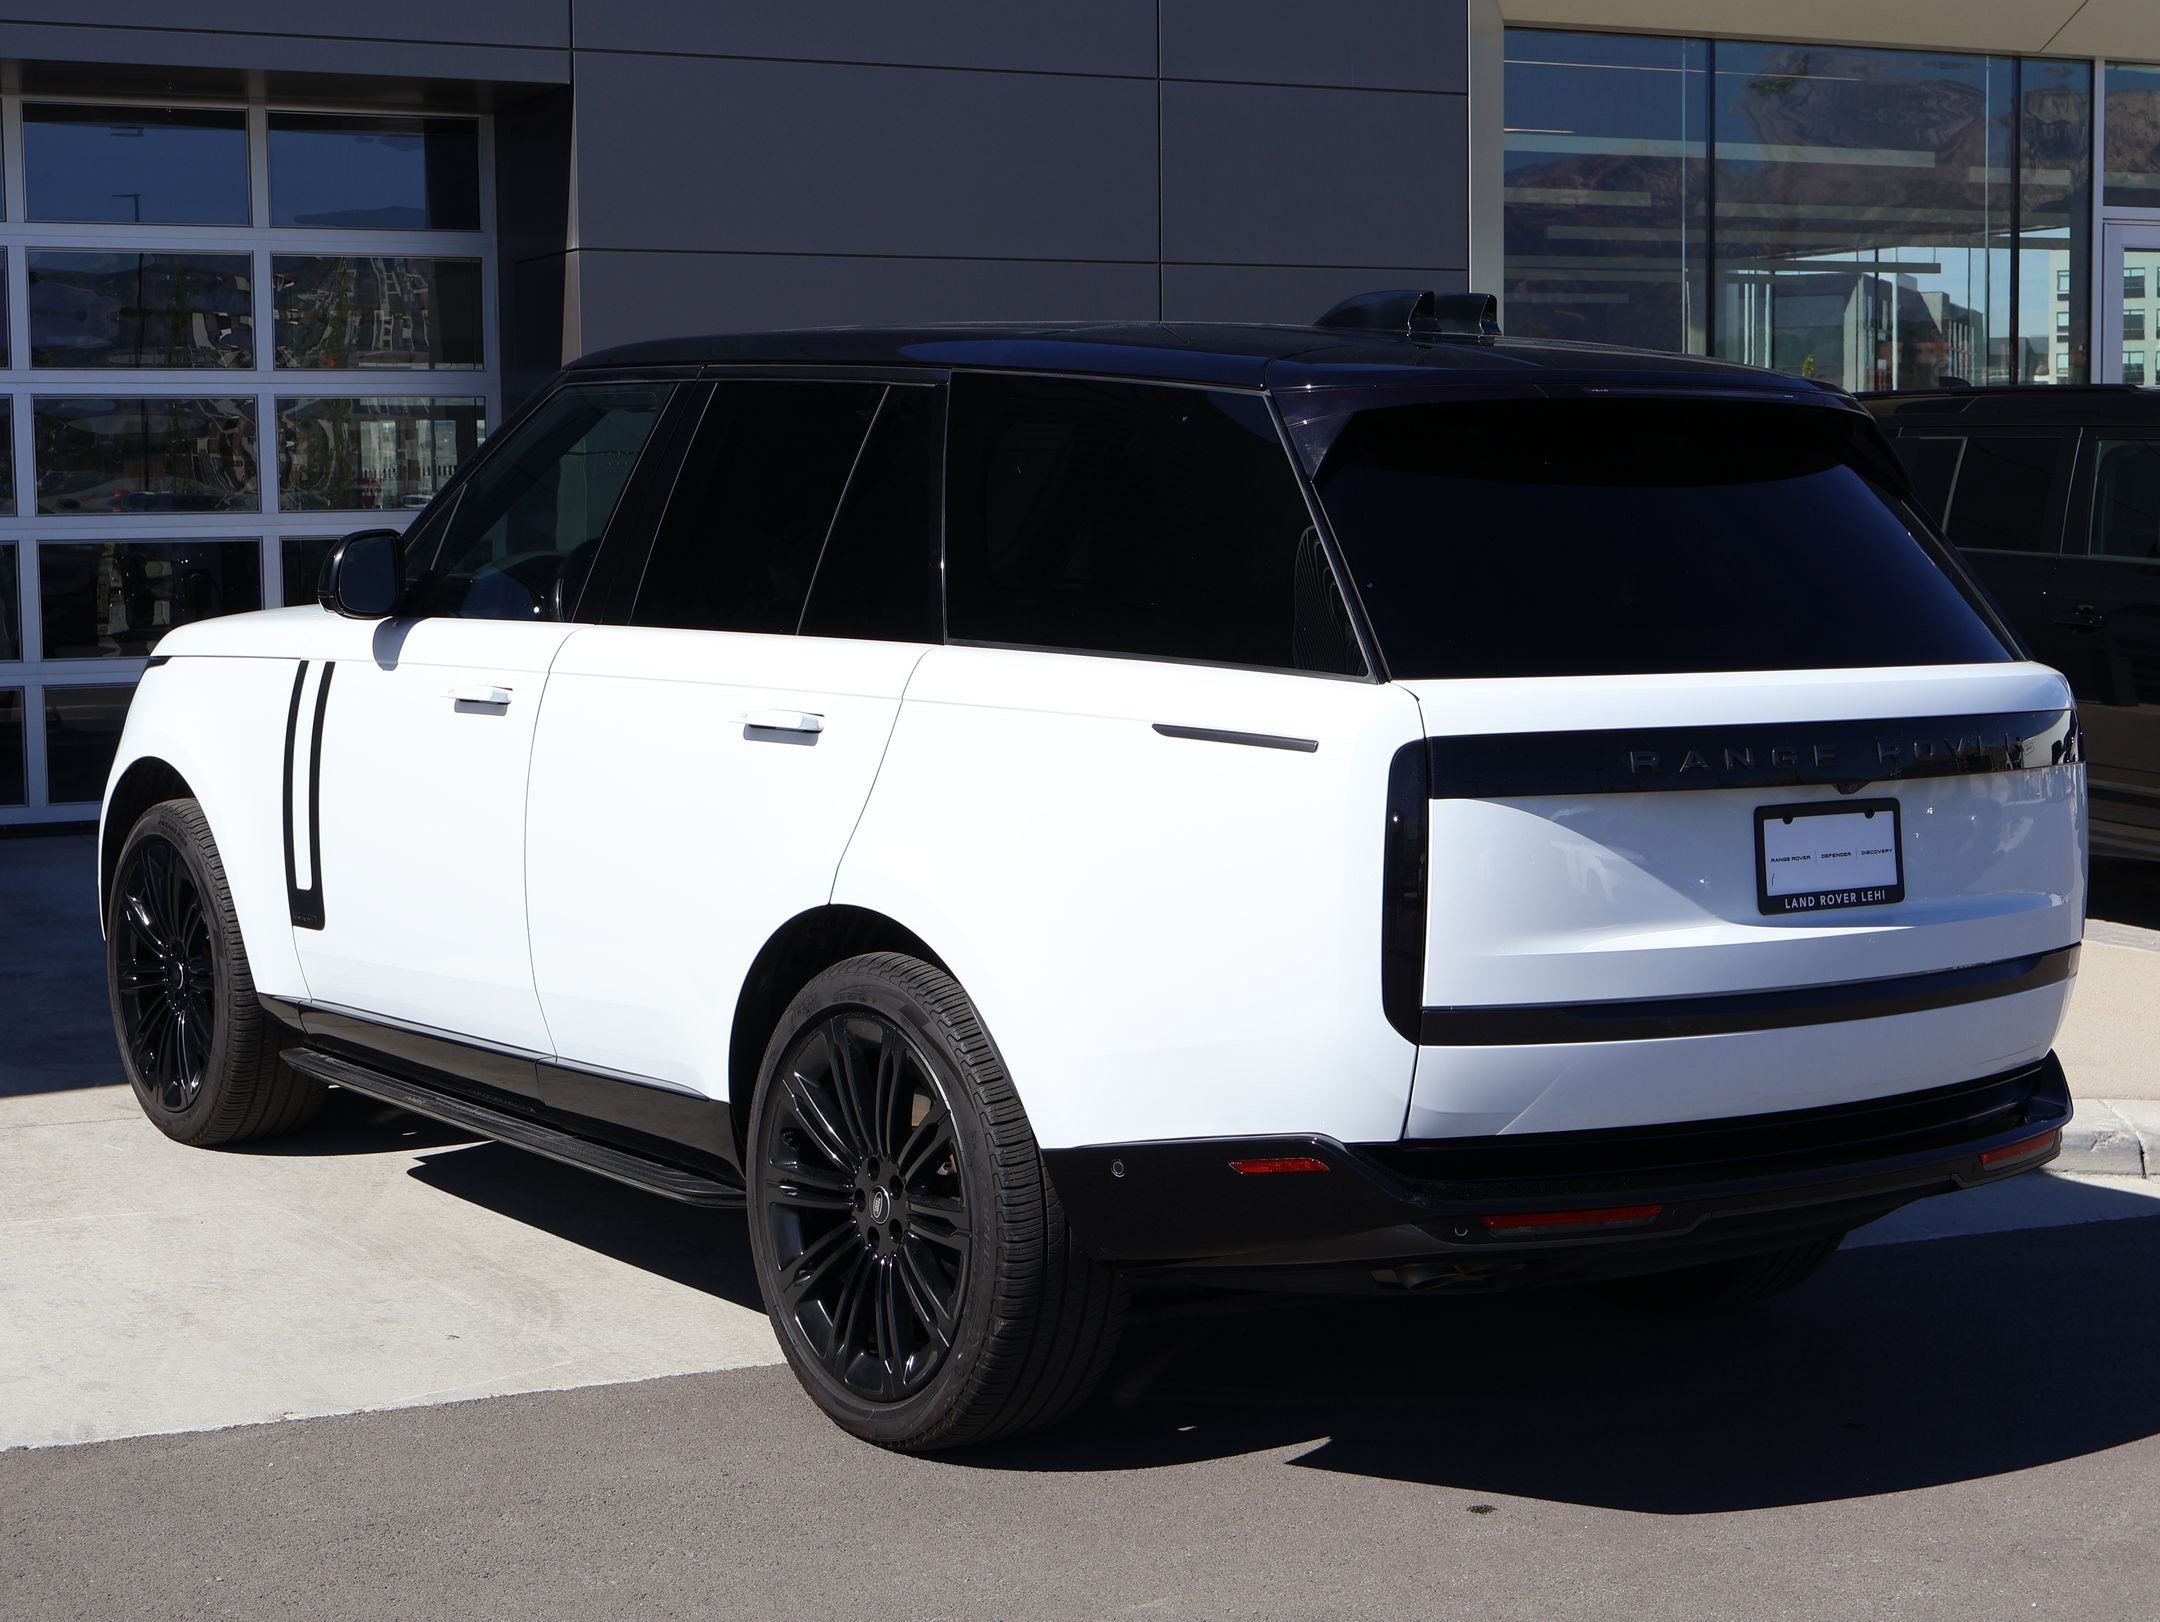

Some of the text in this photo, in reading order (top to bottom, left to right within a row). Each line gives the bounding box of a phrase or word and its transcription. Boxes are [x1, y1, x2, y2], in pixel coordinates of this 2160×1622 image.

[1629, 744, 1839, 774] RANGE
[1820, 851, 1852, 859] DEFENDER
[1861, 848, 1893, 856] DISCOVERY
[1784, 889, 1886, 909] LAND ROVER LEHI
